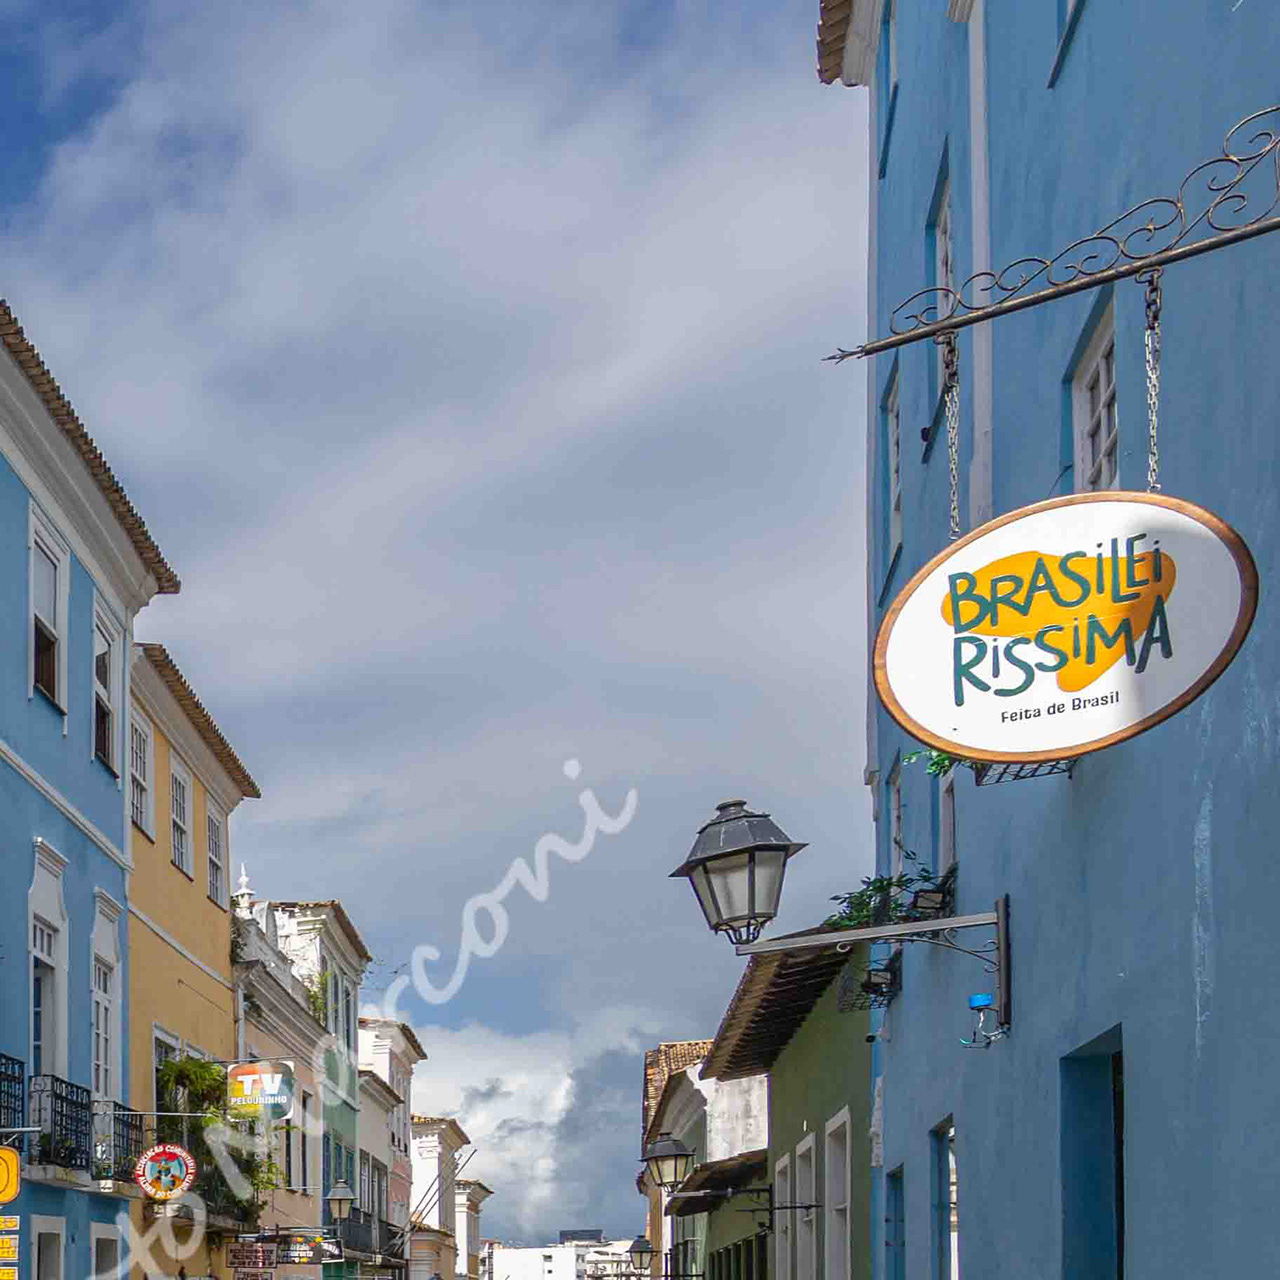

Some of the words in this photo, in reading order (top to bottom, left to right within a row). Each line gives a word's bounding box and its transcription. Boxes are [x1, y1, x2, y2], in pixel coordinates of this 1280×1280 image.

[1000, 706, 1042, 725] Feita
[1046, 701, 1067, 716] de
[1071, 690, 1121, 714] Brasil
[236, 1073, 284, 1096] TV
